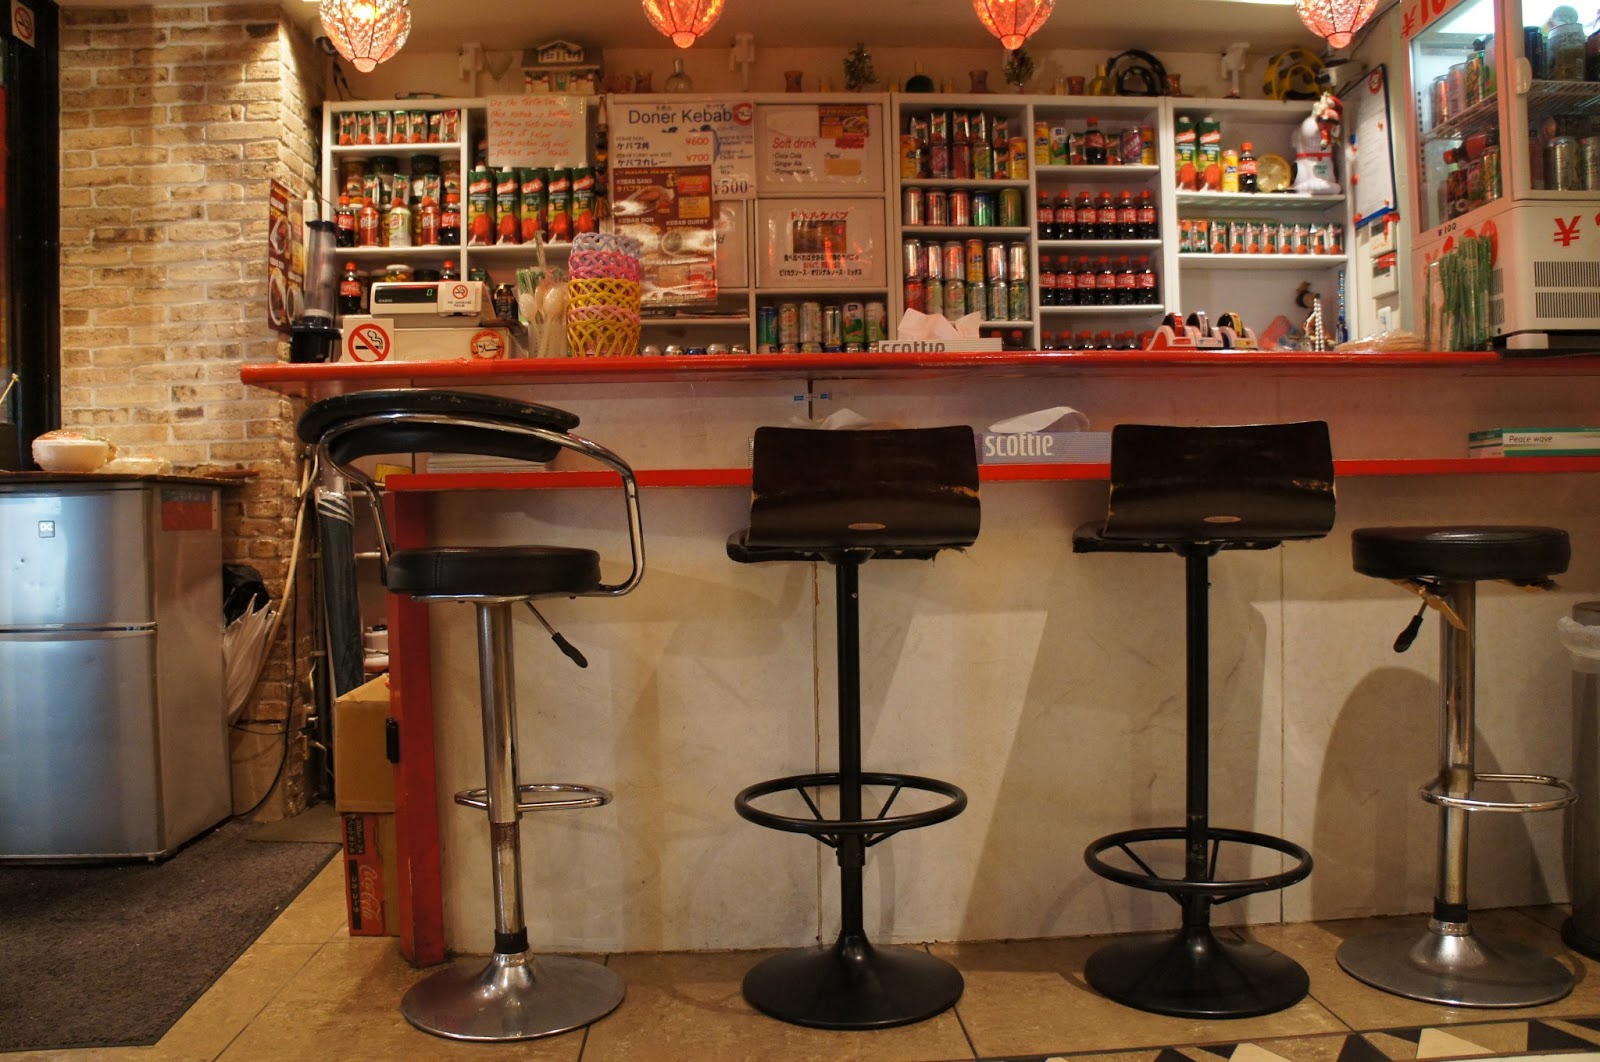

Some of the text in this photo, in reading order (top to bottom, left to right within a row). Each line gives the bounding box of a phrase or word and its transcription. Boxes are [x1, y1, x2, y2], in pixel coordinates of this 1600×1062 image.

[629, 109, 732, 124] Doner Kebab
[685, 137, 710, 146] ¥600
[772, 137, 817, 149] Soft drink
[686, 153, 710, 162] ¥700
[617, 159, 668, 167] ケバブカレー
[426, 288, 433, 297] 0
[1508, 435, 1553, 443] Peace wave
[984, 432, 1054, 457] scottie
